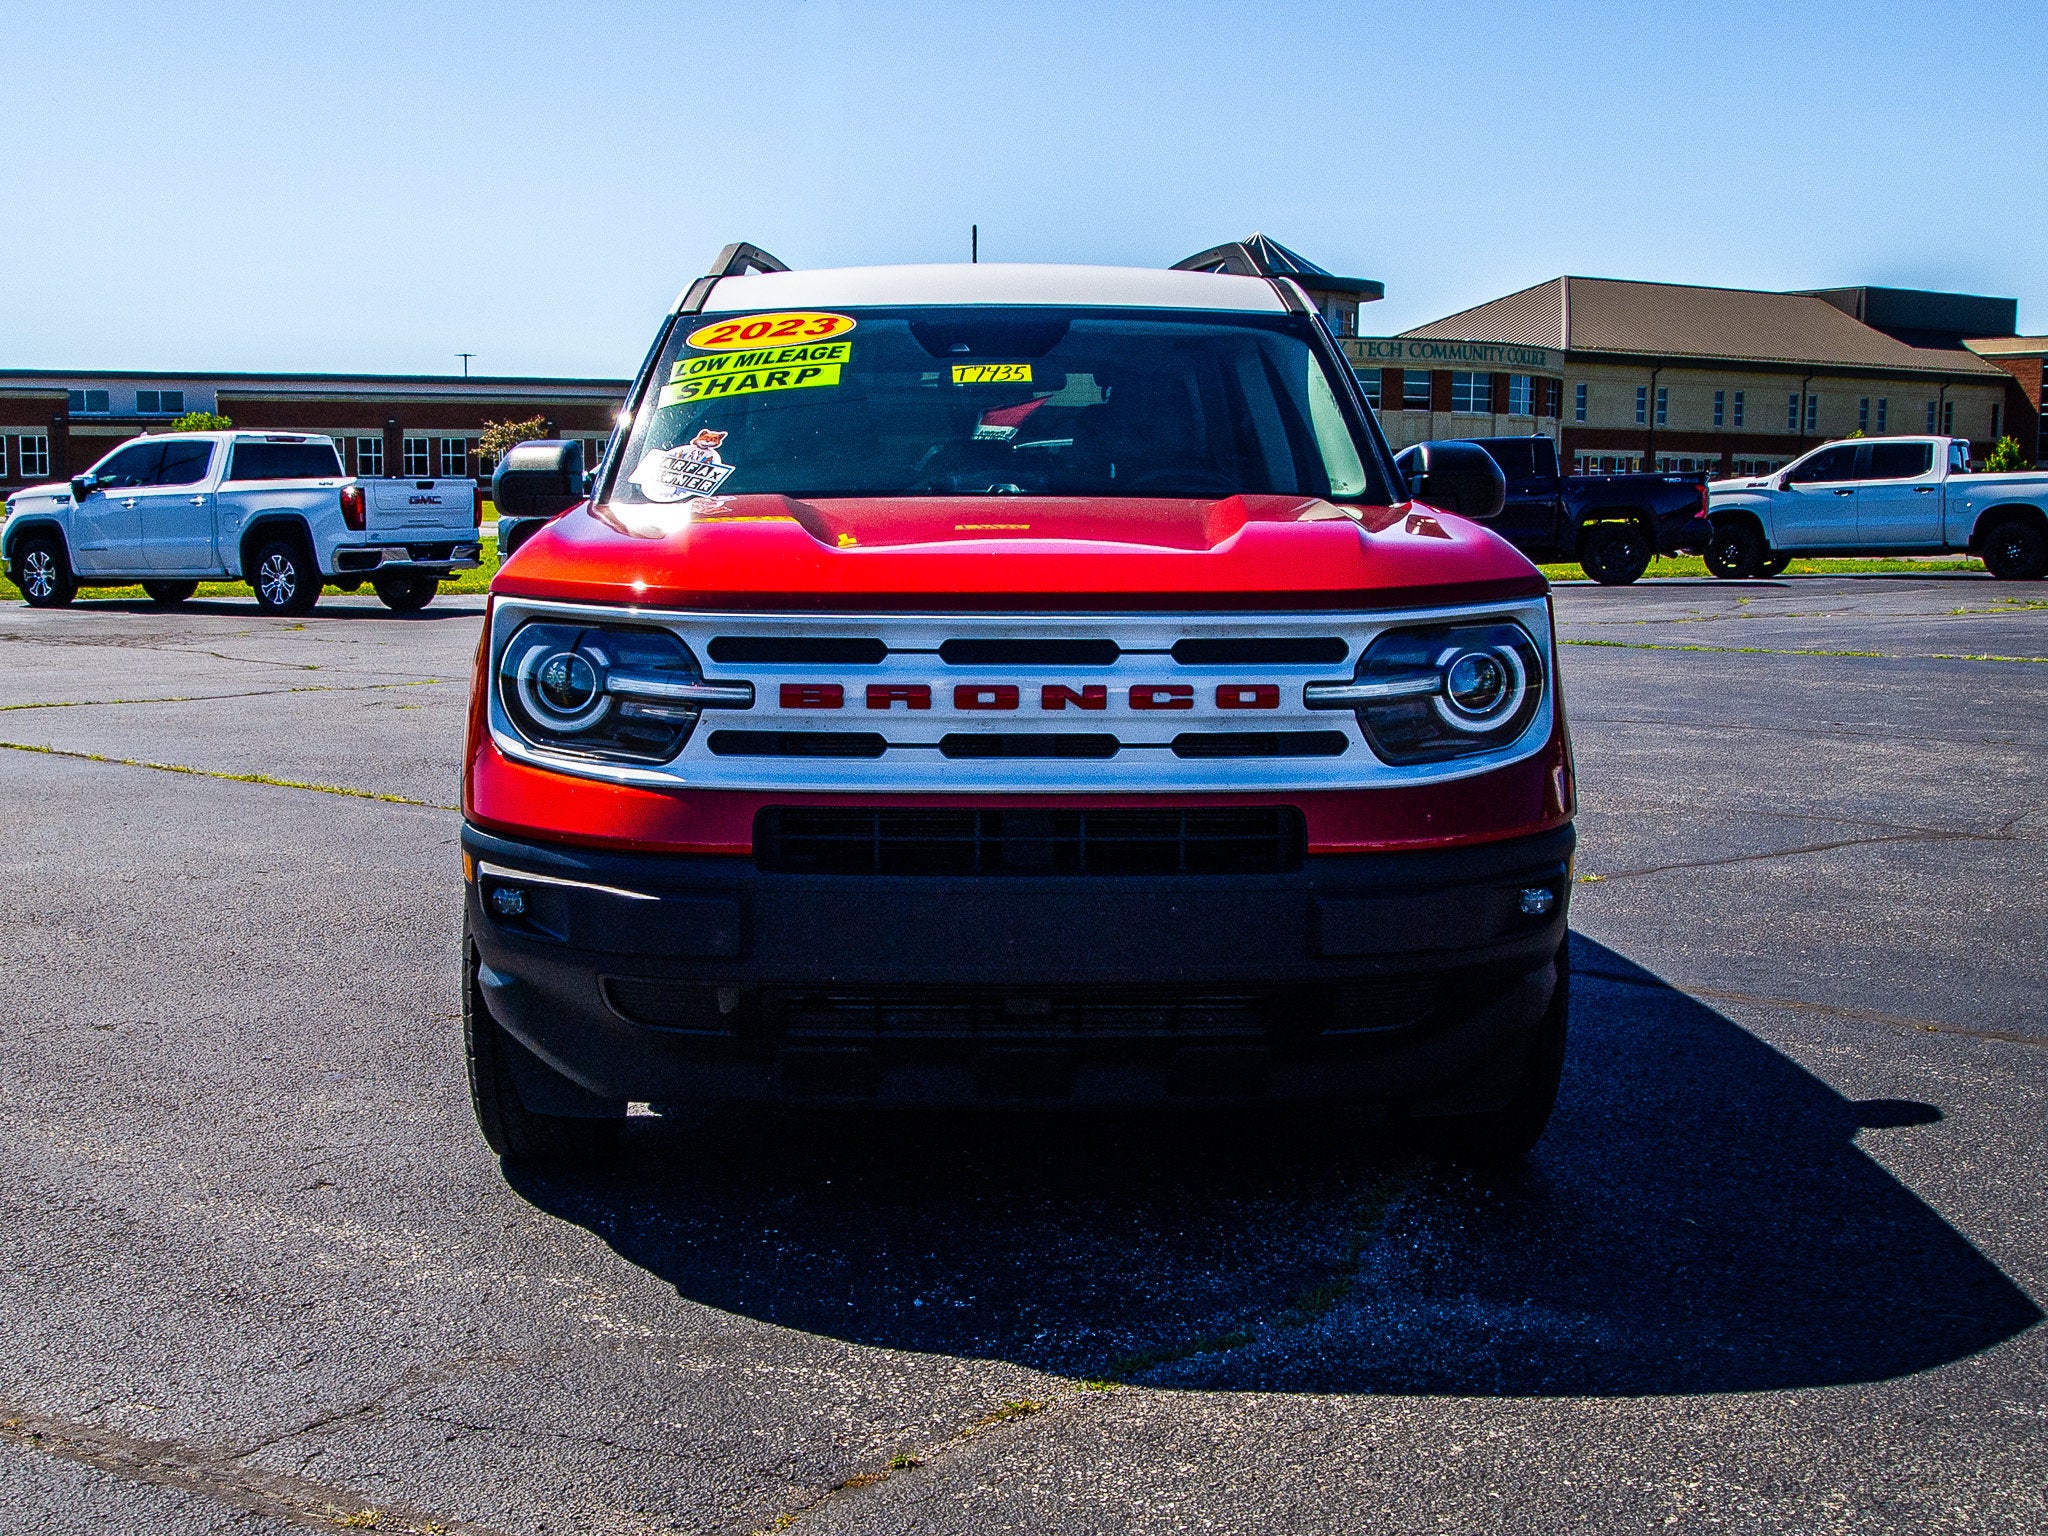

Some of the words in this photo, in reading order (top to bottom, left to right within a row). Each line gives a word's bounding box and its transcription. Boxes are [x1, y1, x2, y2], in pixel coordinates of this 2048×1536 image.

[703, 317, 840, 345] 2023
[675, 355, 730, 377] LOW
[732, 345, 846, 369] MILEAGE
[1355, 341, 1403, 358] TECH
[1408, 341, 1505, 363] COMMUNITY
[1507, 348, 1547, 366] COLLEGE
[677, 367, 822, 400] SHARP
[657, 457, 721, 480] ARFAX
[657, 470, 717, 493] WNER
[408, 495, 442, 505] GMC
[779, 683, 1281, 711] BRONCO
